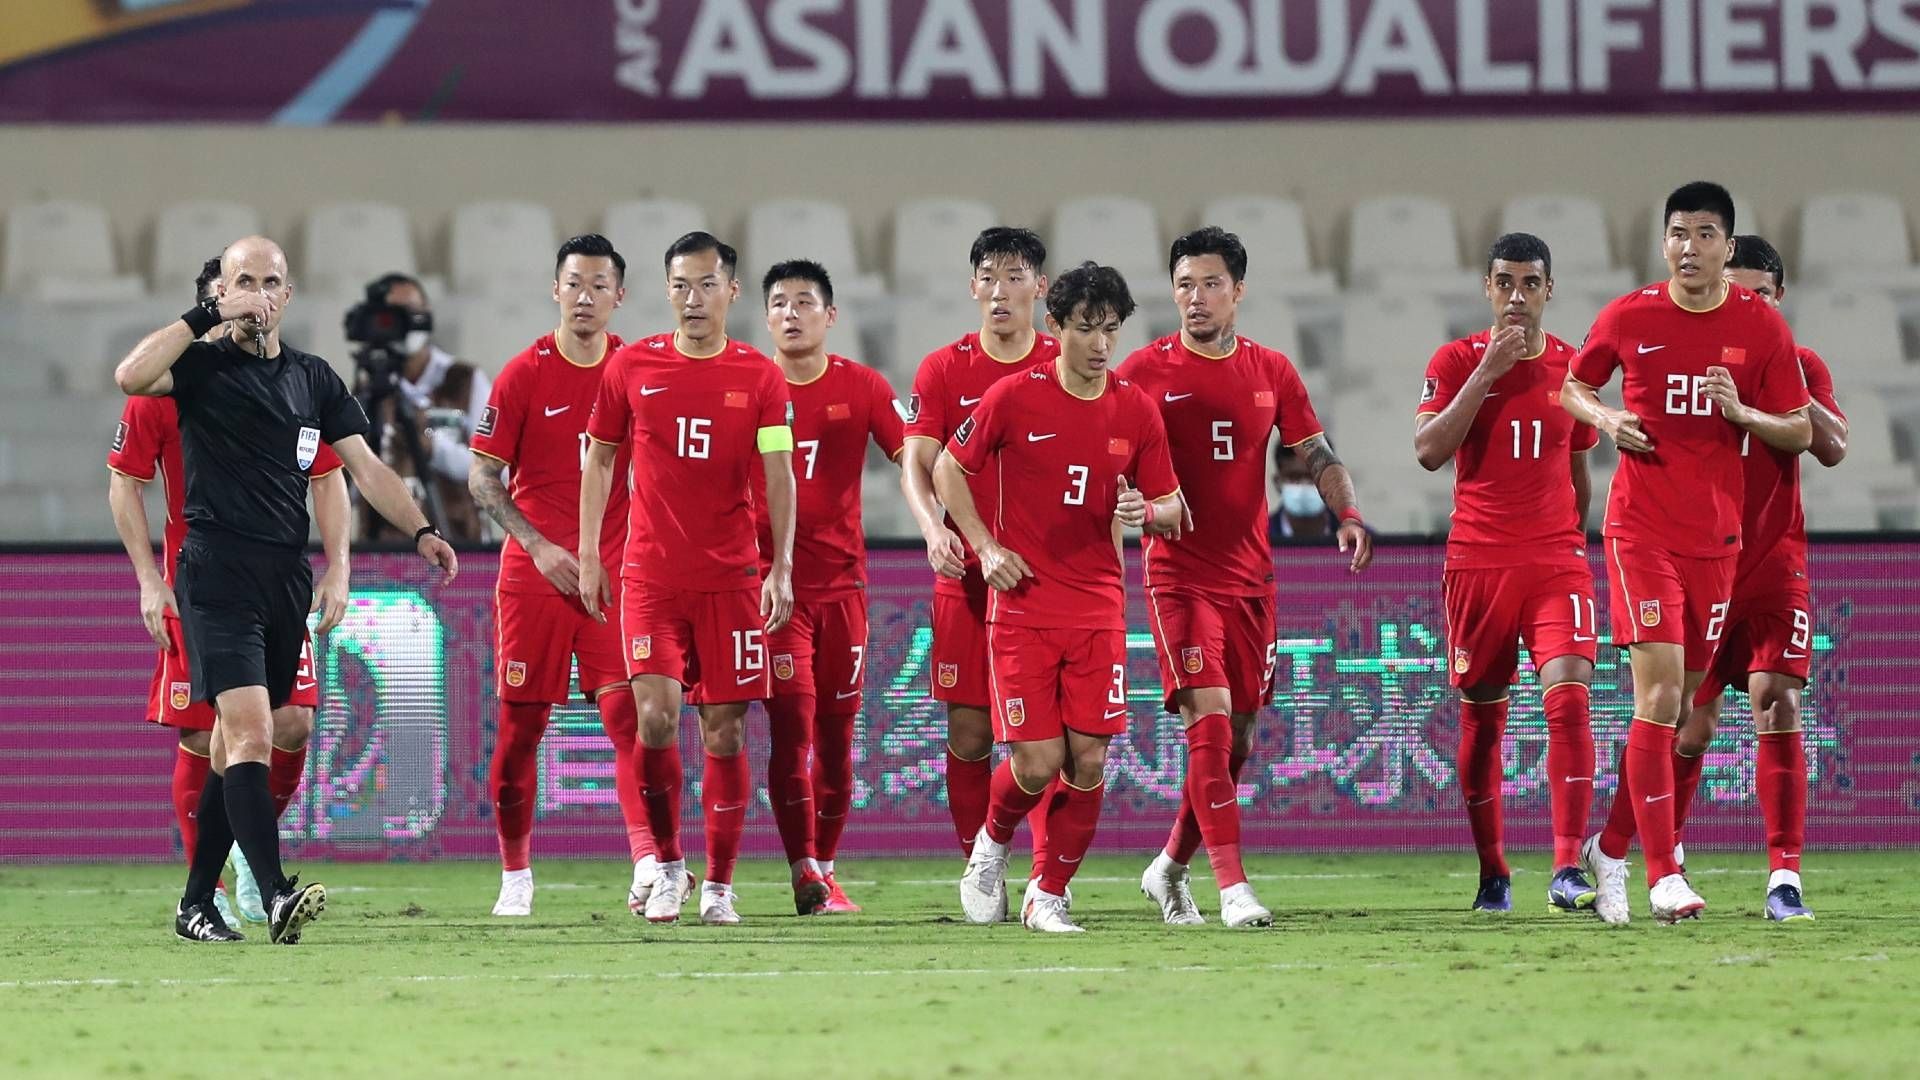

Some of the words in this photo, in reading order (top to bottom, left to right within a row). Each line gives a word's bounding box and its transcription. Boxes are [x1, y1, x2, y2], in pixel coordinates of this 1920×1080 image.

[671, 0, 1107, 98] ASIAN
[1135, 0, 1920, 96] QUALIFIERS
[1665, 373, 1713, 416] 20
[301, 430, 317, 442] FIFA
[676, 416, 712, 459] 15
[1212, 421, 1234, 460] 5
[1510, 420, 1542, 459] 11
[797, 440, 819, 480] 7
[1063, 464, 1089, 505] 3
[1569, 593, 1596, 635] 11
[1706, 601, 1729, 641] 2
[1790, 608, 1810, 650] 9
[732, 629, 763, 670] 15
[850, 645, 864, 685] 7
[1263, 642, 1277, 682] 5
[1108, 663, 1125, 704] 3
